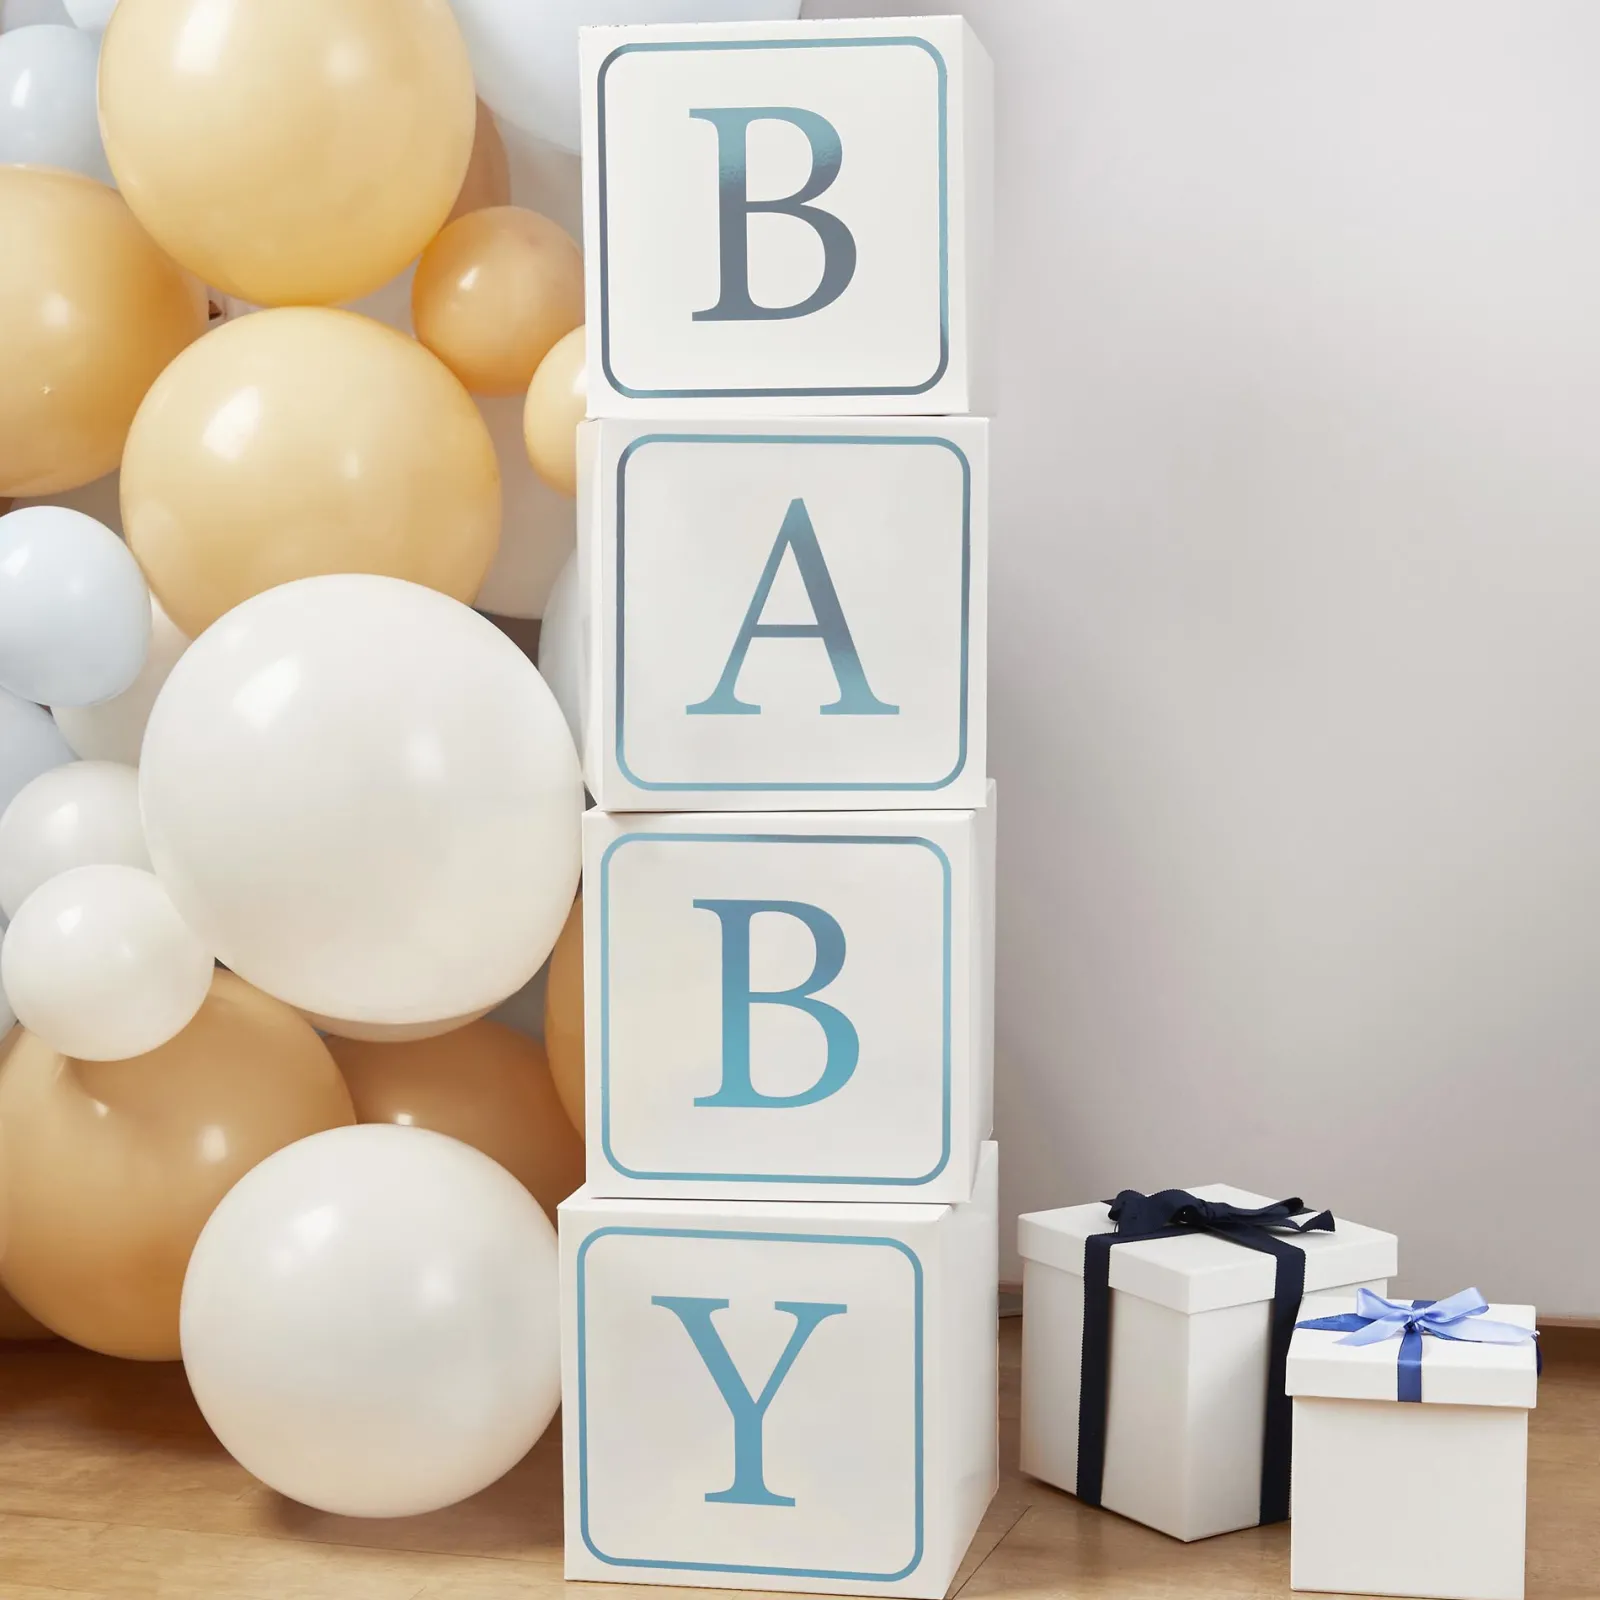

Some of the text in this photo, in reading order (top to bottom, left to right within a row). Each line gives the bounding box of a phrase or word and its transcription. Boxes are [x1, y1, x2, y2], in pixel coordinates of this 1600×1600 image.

[689, 106, 857, 322] B
[685, 497, 900, 716] A
[692, 898, 860, 1109] B
[650, 1295, 848, 1507] Y
